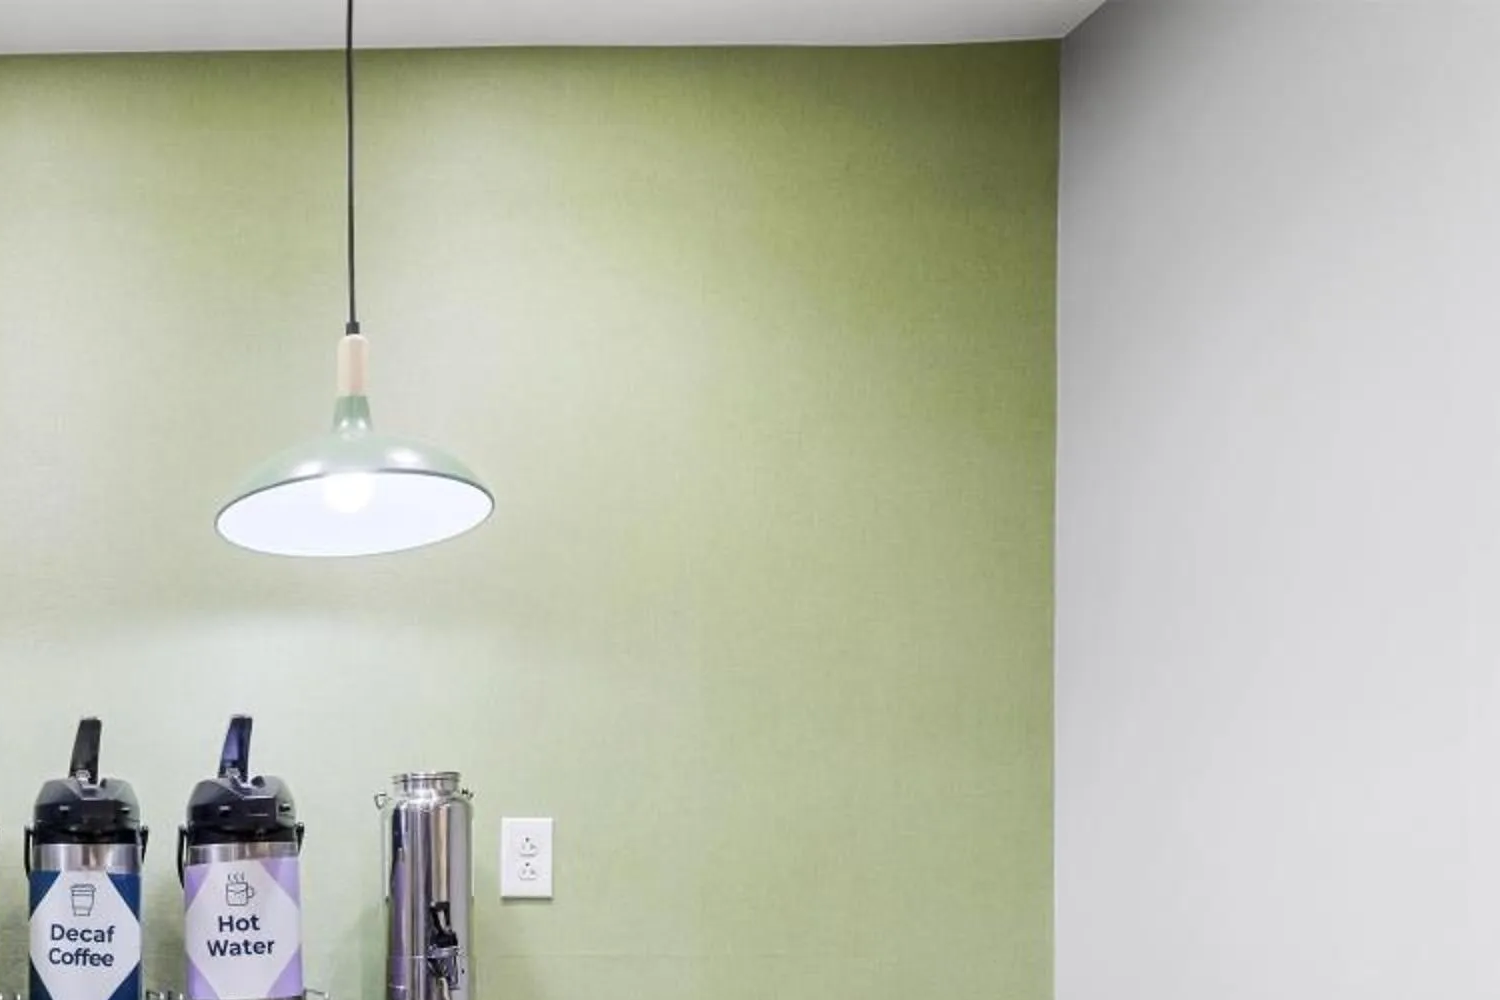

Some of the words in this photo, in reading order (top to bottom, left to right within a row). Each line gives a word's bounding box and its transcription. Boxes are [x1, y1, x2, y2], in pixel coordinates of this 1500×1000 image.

[218, 914, 260, 932] Hot
[51, 923, 116, 943] Decaf
[49, 947, 115, 967] Coffee
[207, 939, 275, 957] Water
